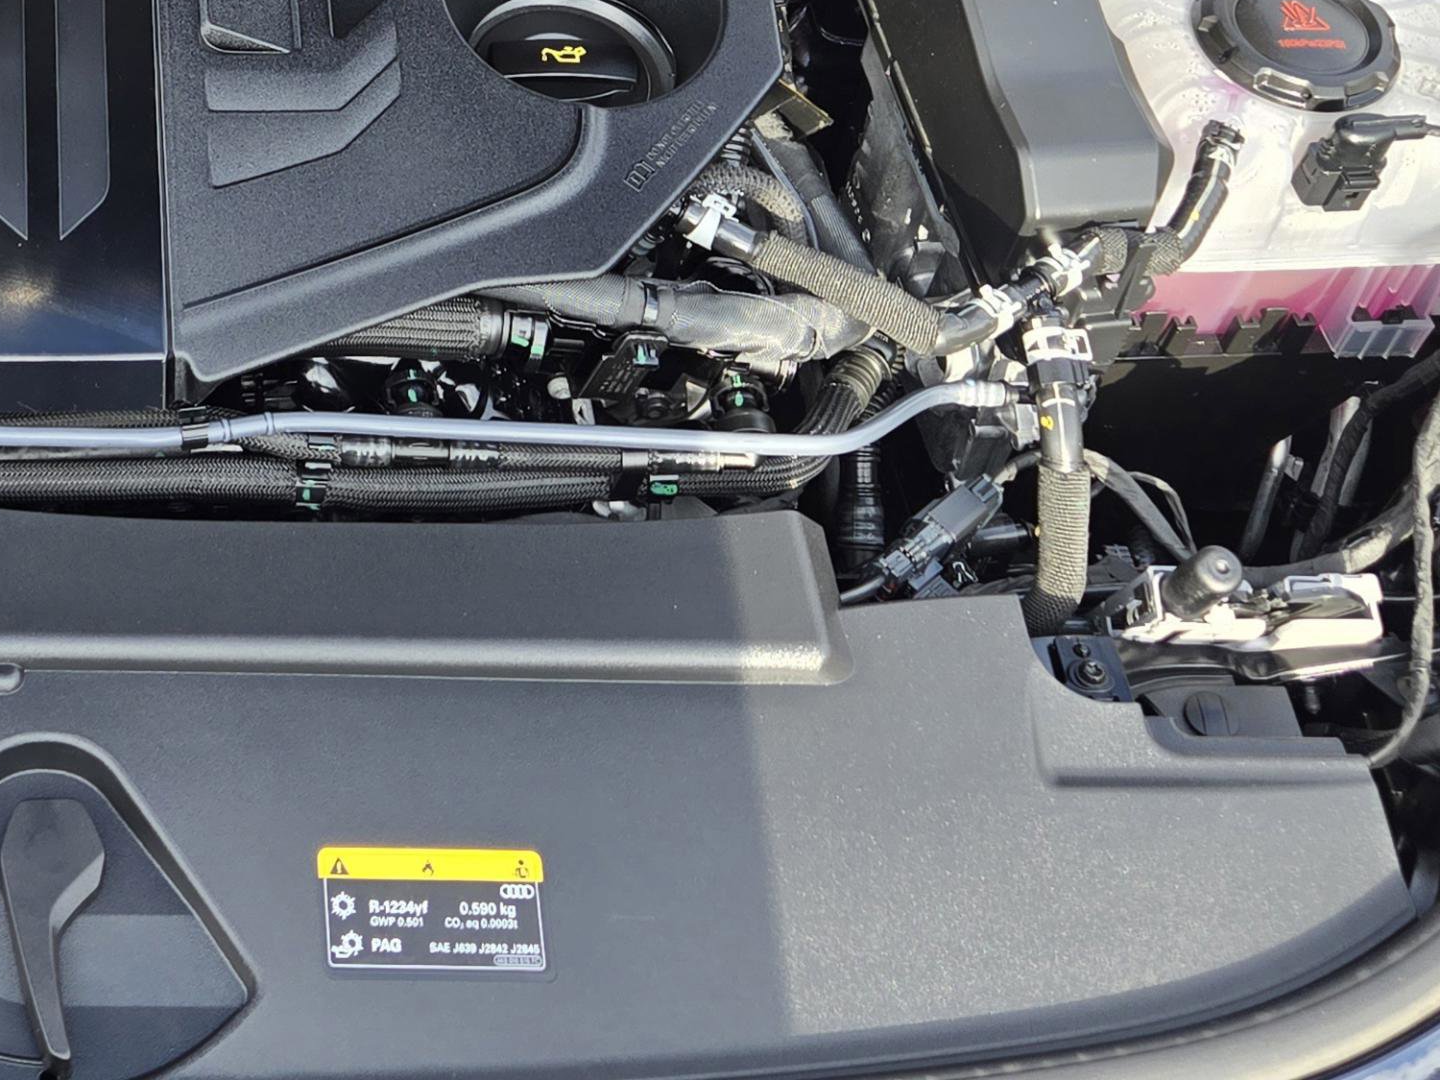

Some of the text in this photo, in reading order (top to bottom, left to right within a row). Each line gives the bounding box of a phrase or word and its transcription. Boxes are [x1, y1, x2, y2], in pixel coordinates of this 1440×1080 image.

[369, 899, 516, 918] R-1234yf 0.590 kg
[369, 916, 395, 928] GWP
[371, 938, 402, 953] PAG
[429, 942, 451, 954] SAE
